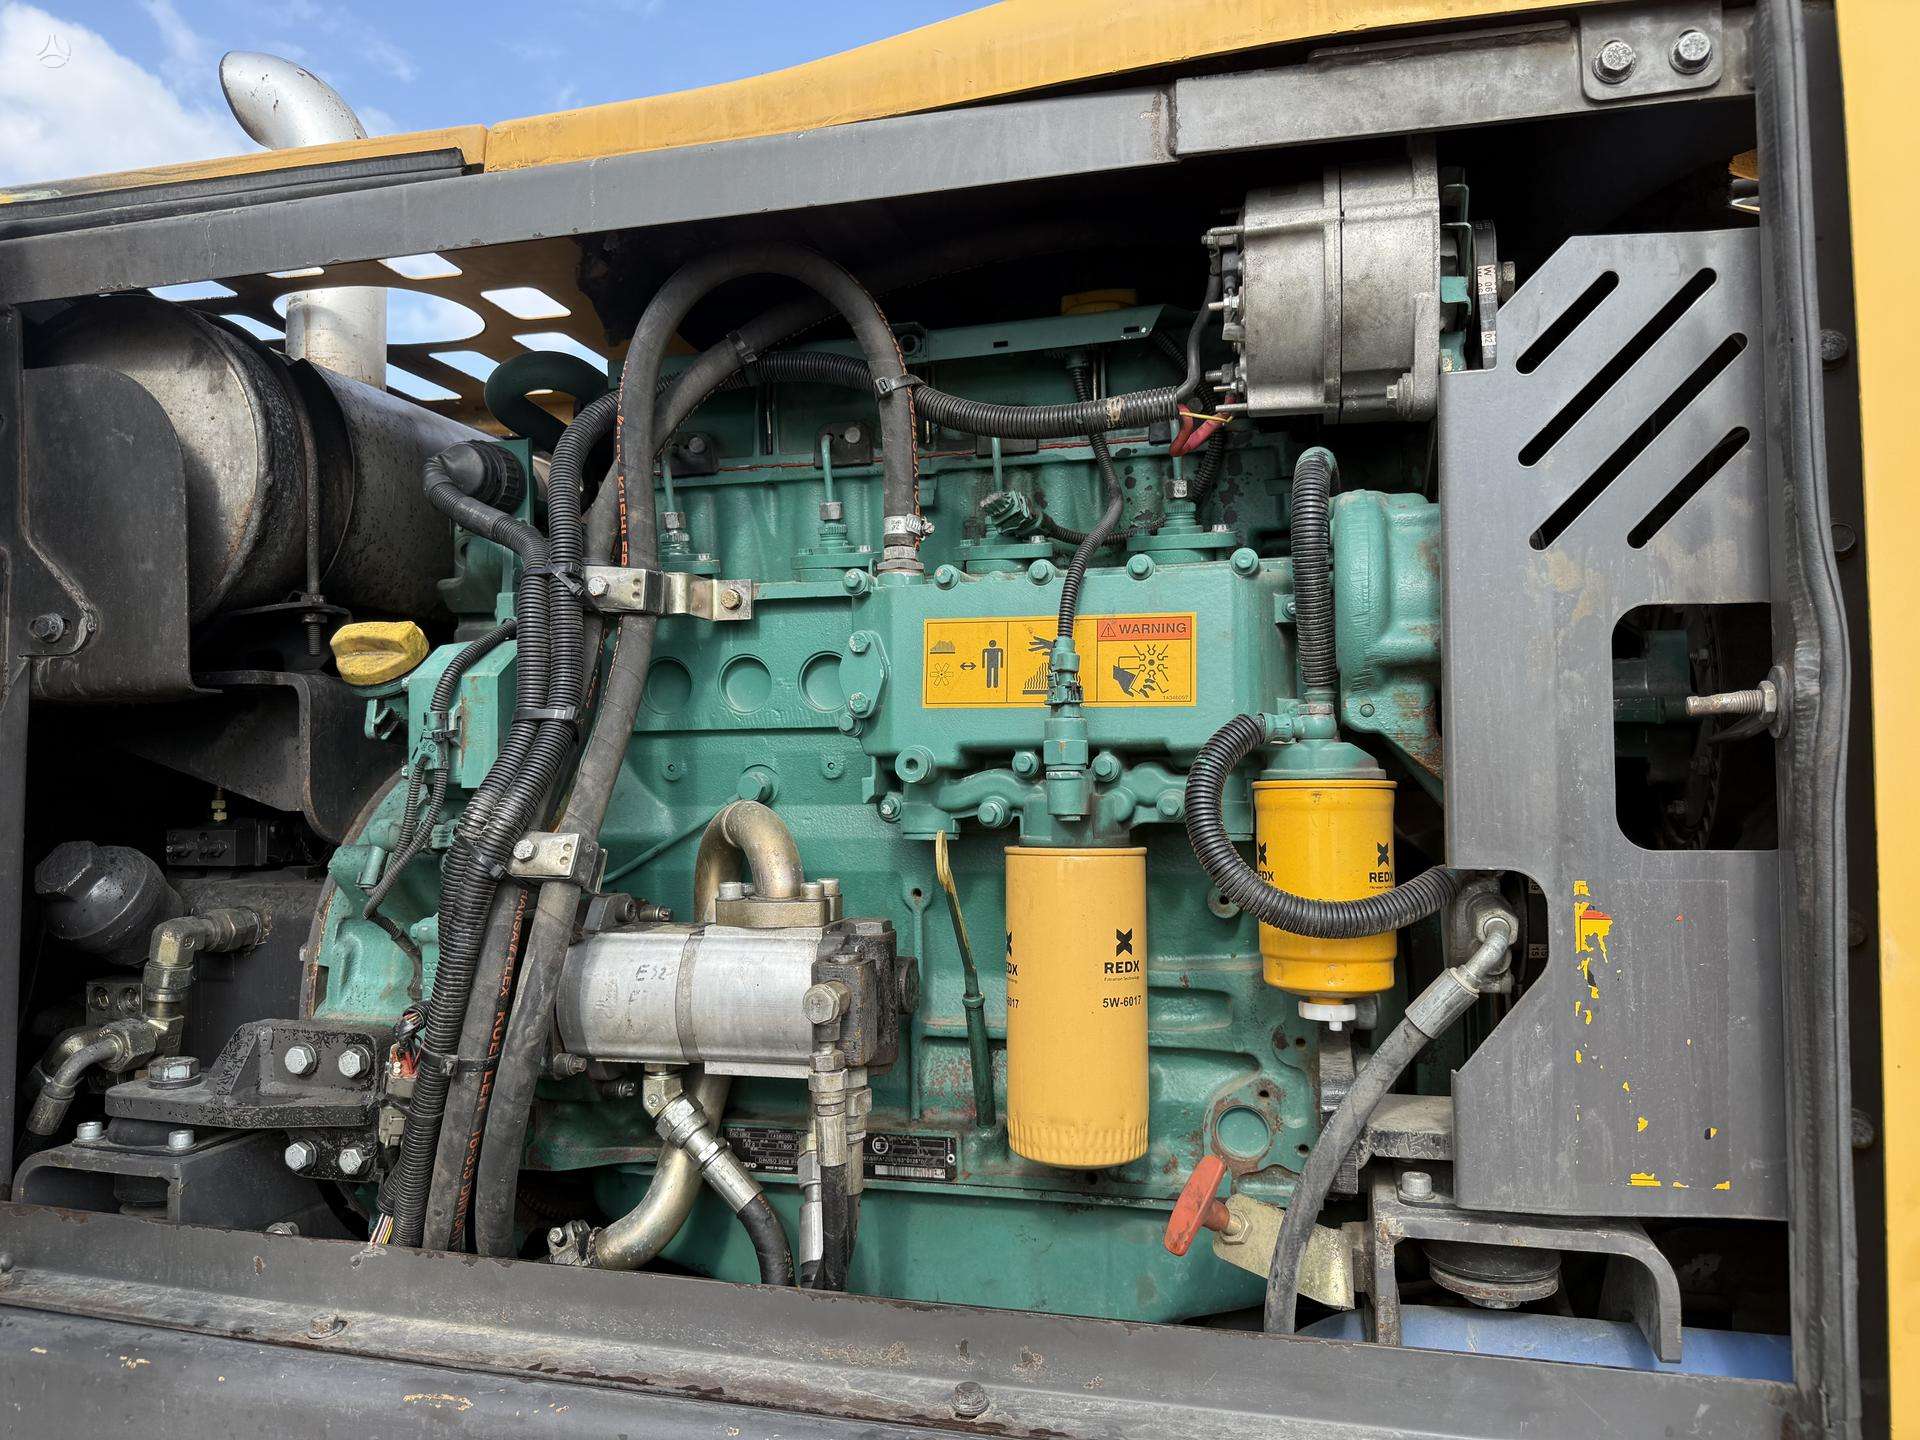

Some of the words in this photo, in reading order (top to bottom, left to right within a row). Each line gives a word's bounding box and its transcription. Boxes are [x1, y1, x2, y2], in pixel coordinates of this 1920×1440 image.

[1119, 622, 1187, 635] WARNING
[1369, 871, 1394, 883] REDX
[1104, 960, 1140, 974] REDX
[1103, 995, 1141, 1008] 5W-6017
